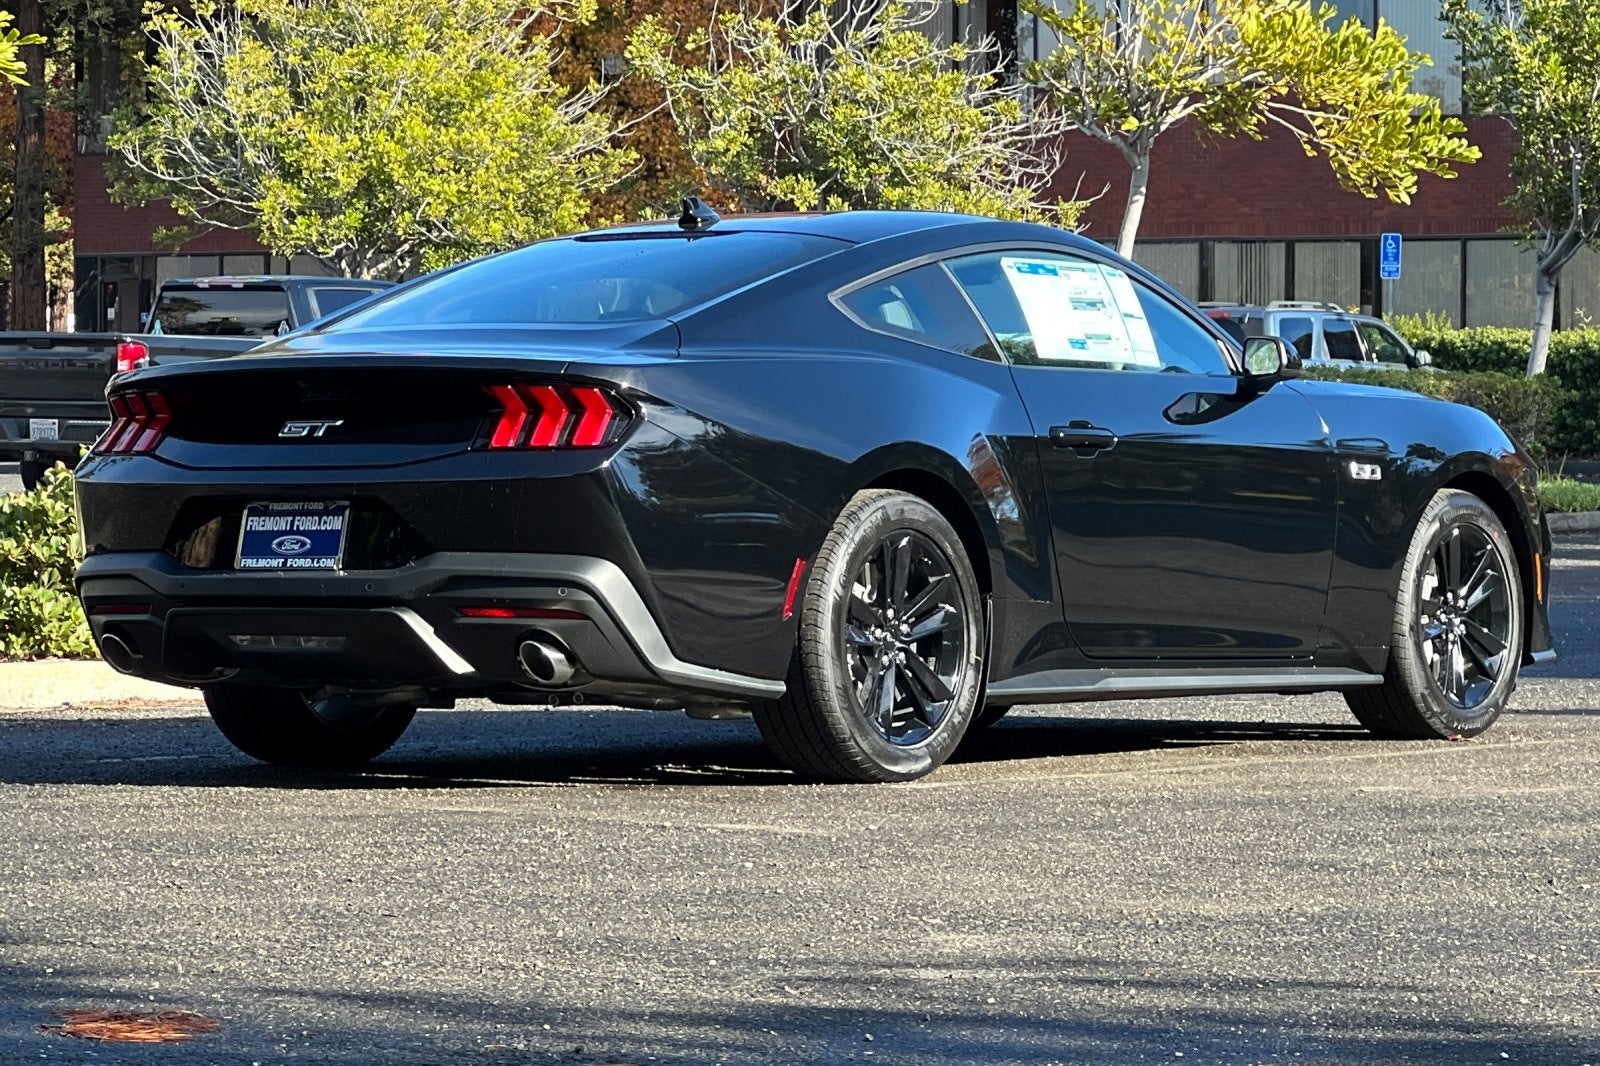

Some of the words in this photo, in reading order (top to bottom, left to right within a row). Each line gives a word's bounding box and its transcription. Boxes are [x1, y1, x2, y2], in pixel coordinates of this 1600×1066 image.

[278, 420, 344, 437] GT
[269, 502, 303, 510] FREMONT
[304, 502, 324, 510] FORD
[246, 516, 292, 531] FREMONT
[293, 516, 342, 531] FORD.COM
[281, 539, 301, 550] Ford
[240, 558, 284, 568] FREMONT
[286, 558, 335, 568] FORD.COM
